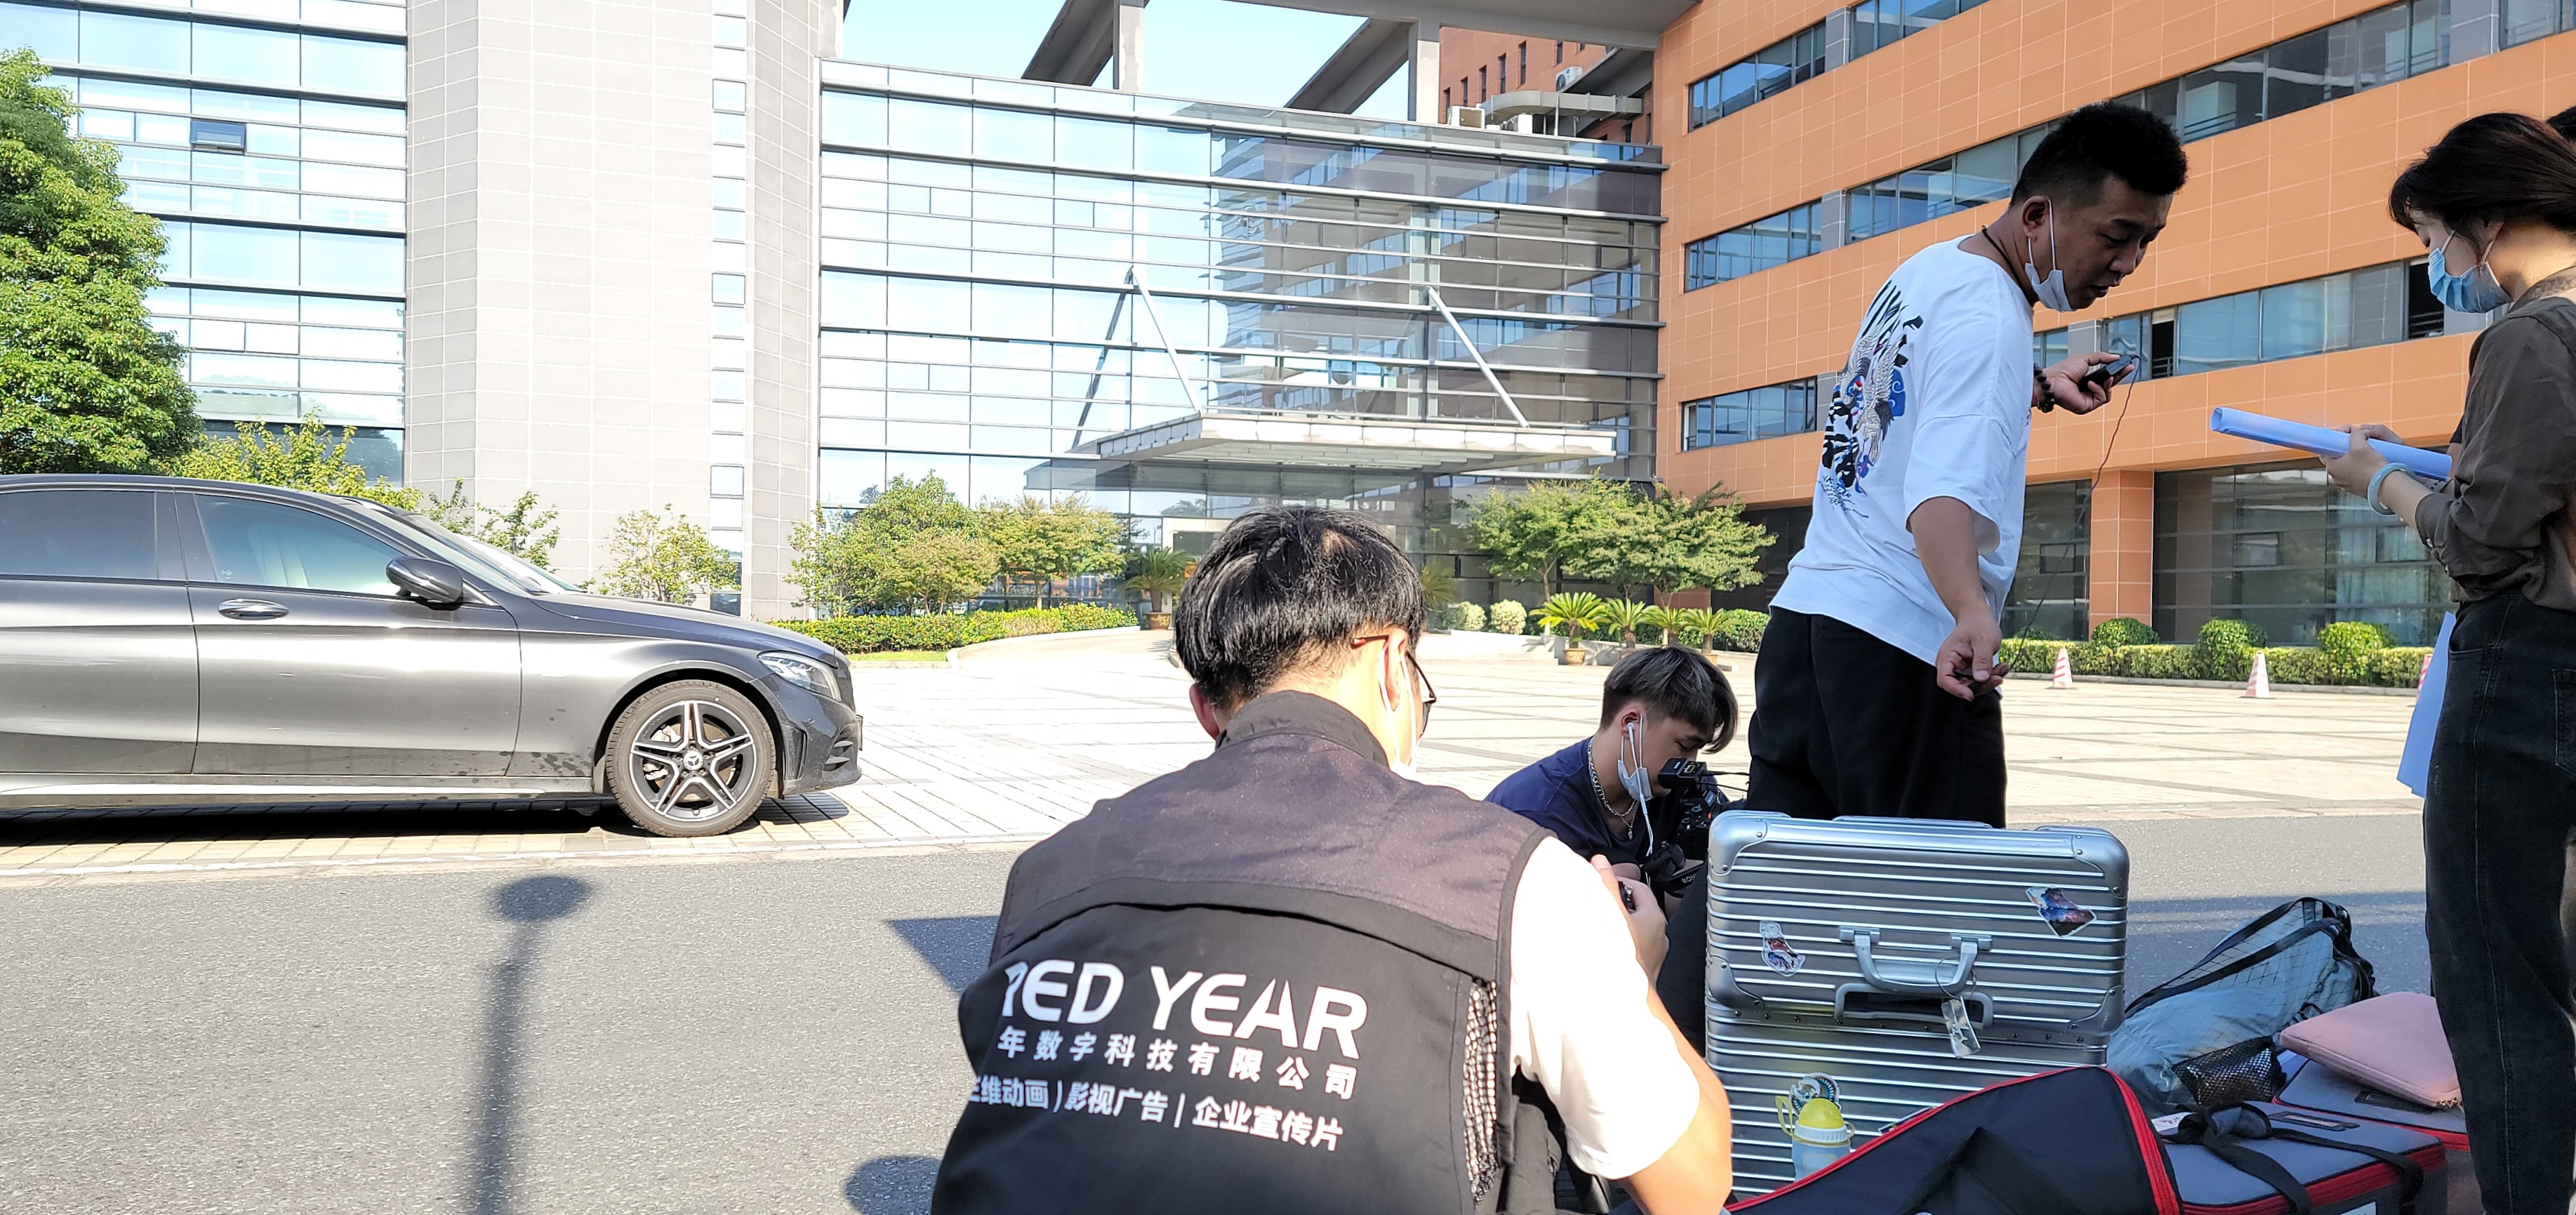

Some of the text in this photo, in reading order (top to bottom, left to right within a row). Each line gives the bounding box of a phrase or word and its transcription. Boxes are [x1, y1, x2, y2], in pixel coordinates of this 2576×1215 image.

[1150, 966, 1368, 1059] YEAR
[997, 1025, 1358, 1101] 年数字科技有限公司
[1192, 1096, 1343, 1152] 企业宣传片
